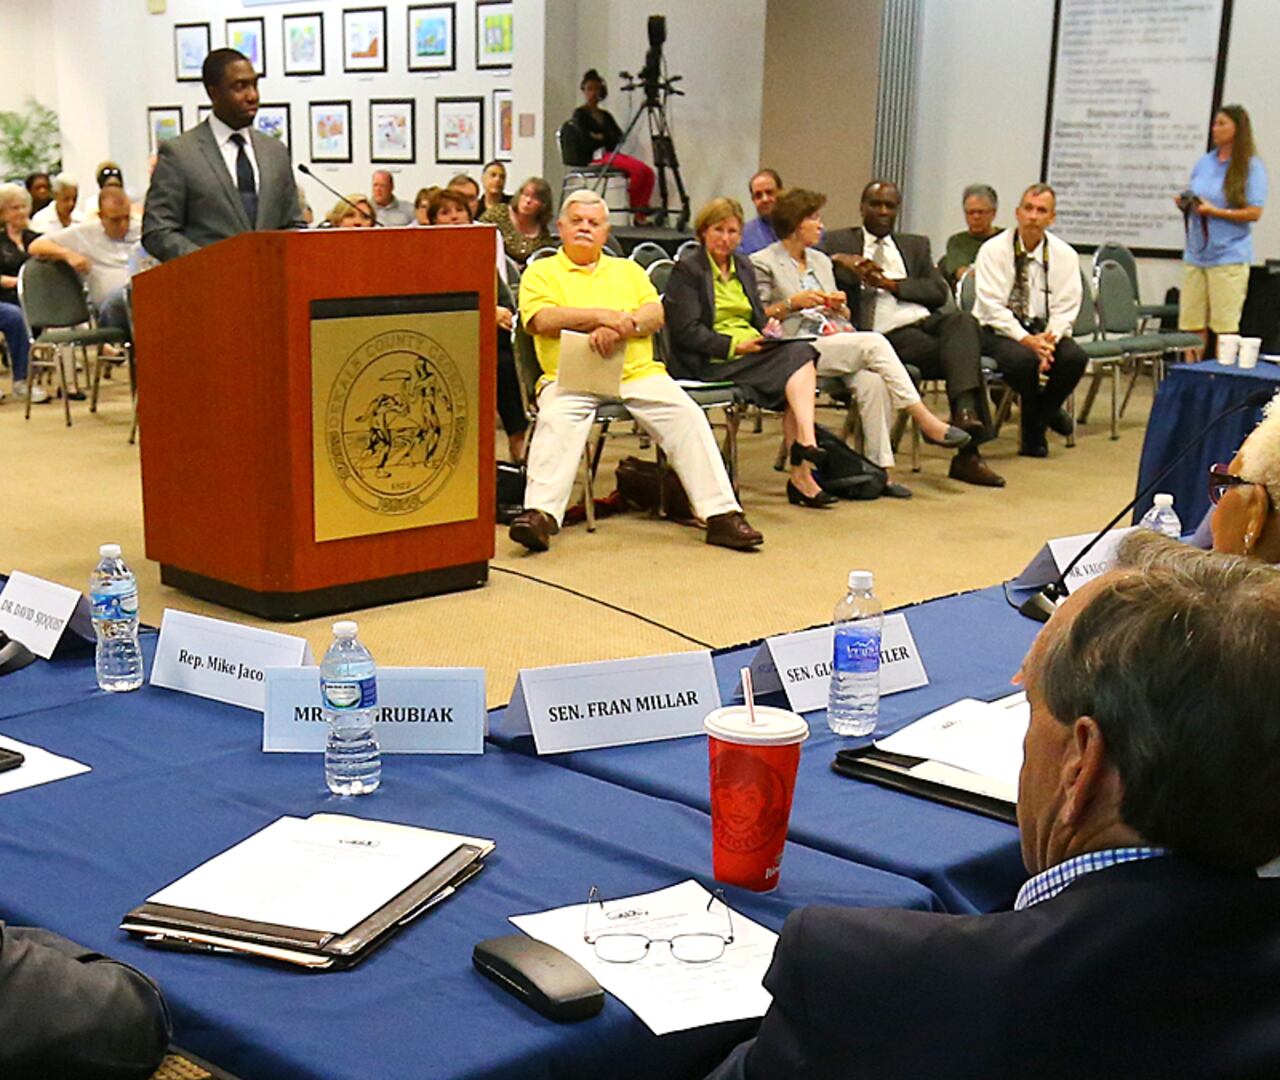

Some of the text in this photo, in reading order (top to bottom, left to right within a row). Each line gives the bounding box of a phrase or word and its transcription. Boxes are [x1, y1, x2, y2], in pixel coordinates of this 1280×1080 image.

[365, 333, 425, 357] COUNTY
[178, 648, 267, 683] Rep. Mike Jaco
[786, 665, 814, 683] SEN.
[880, 645, 911, 665] TLER
[375, 706, 454, 723] RUBIAK
[548, 690, 700, 723] SEN. FRAN MILLAR
